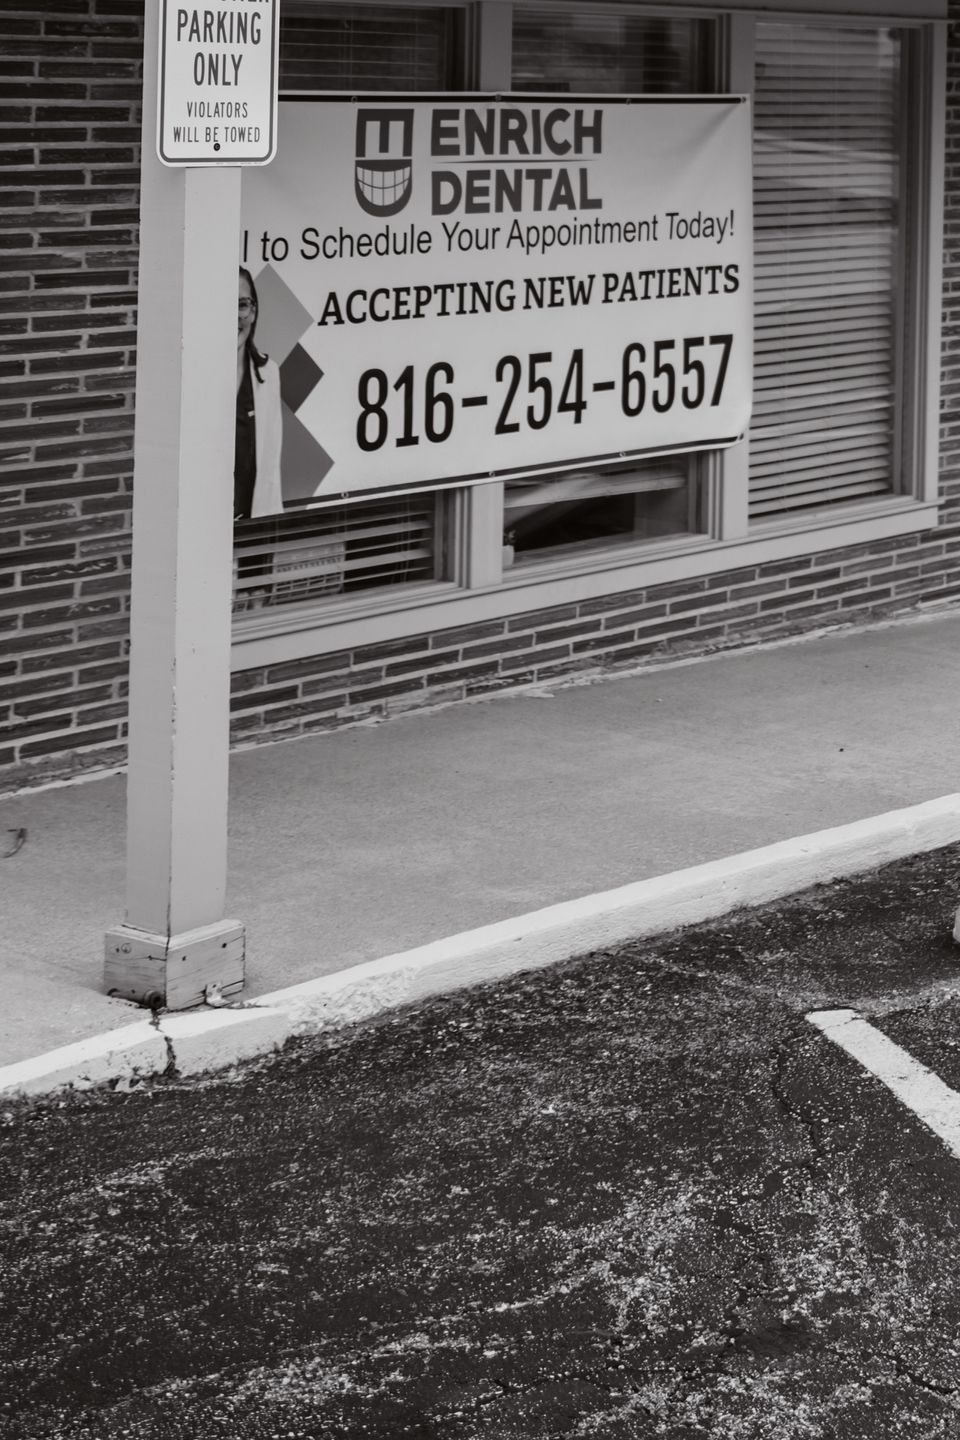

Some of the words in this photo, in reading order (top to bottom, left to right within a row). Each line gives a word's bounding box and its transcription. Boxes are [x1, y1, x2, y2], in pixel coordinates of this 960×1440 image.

[176, 9, 262, 45] PARKING
[193, 52, 243, 86] ONLY
[187, 101, 248, 118] VIOLATORS
[430, 108, 603, 156] ENRICH
[173, 126, 200, 143] WILL
[205, 126, 219, 143] BE
[224, 126, 261, 143] TOWED
[431, 167, 603, 216] DENTAL
[261, 231, 289, 262] to
[300, 223, 432, 260] Schedule
[441, 221, 501, 252] Your
[506, 214, 659, 255] Appointment
[665, 209, 735, 244] Today!
[317, 279, 516, 326] ACCEPTING
[522, 274, 596, 310] NEW
[601, 264, 740, 304] PATIENTS
[356, 334, 734, 452] 816-254-6557
